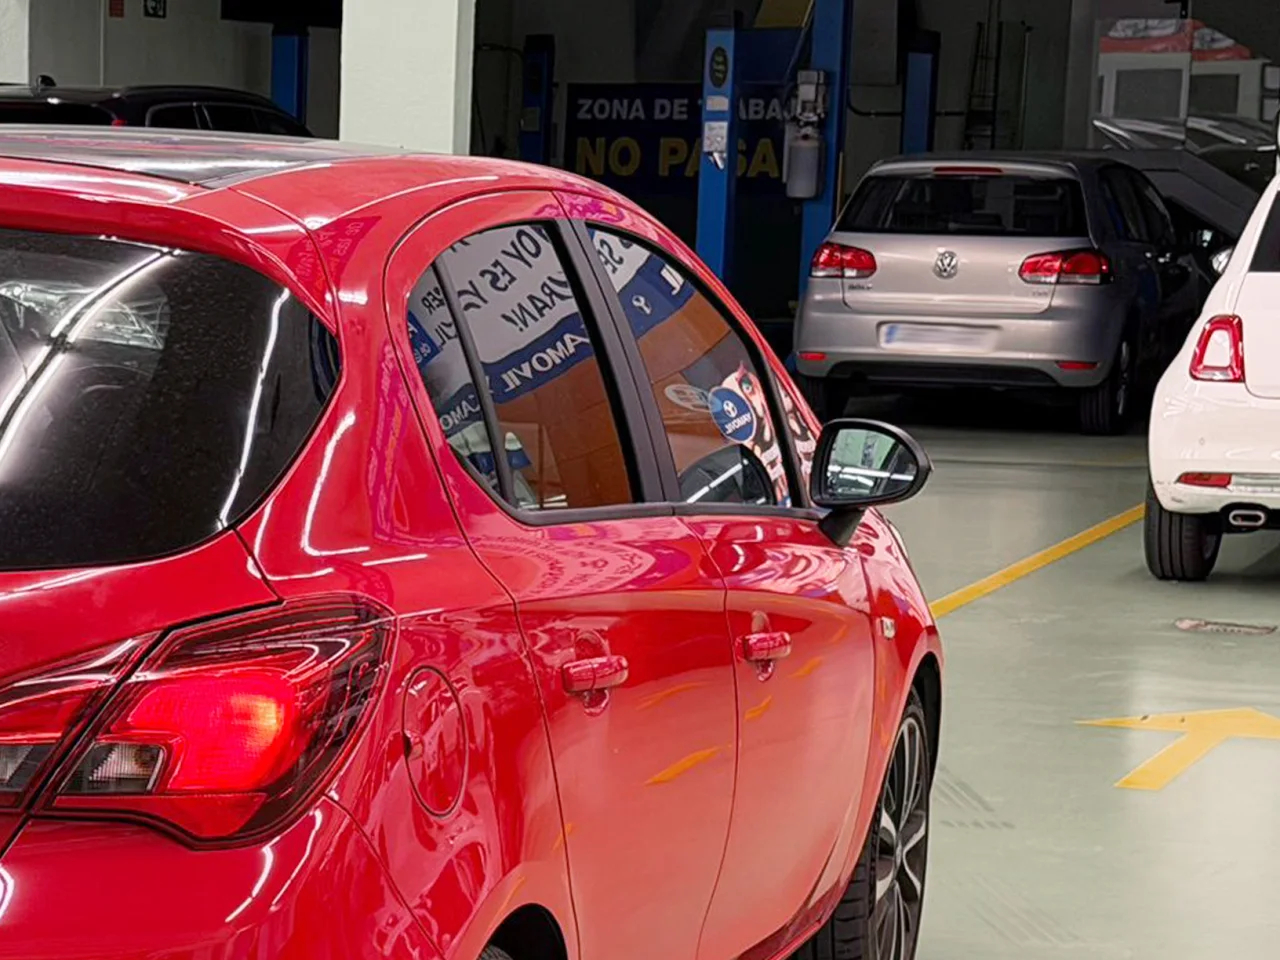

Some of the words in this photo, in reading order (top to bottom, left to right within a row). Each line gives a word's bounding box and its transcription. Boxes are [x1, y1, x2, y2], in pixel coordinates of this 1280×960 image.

[577, 98, 645, 120] ZONA
[654, 98, 688, 120] DE
[575, 136, 642, 177] NO
